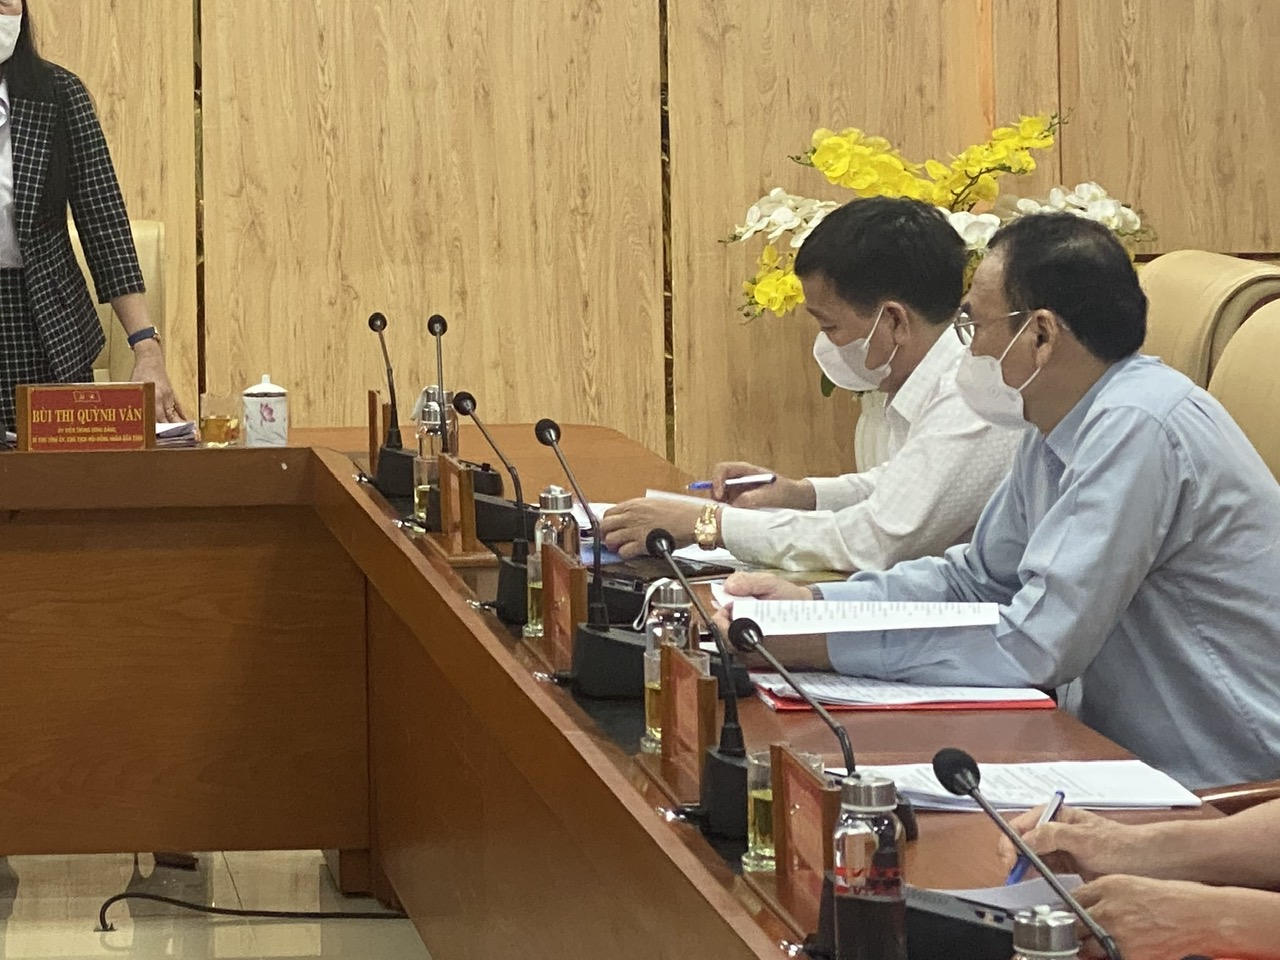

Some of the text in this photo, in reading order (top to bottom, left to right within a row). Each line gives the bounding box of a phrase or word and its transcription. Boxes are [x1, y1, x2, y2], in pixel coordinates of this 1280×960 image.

[32, 406, 52, 423] BÙI
[54, 409, 75, 425] THỊ
[77, 406, 116, 425] QUỲNH
